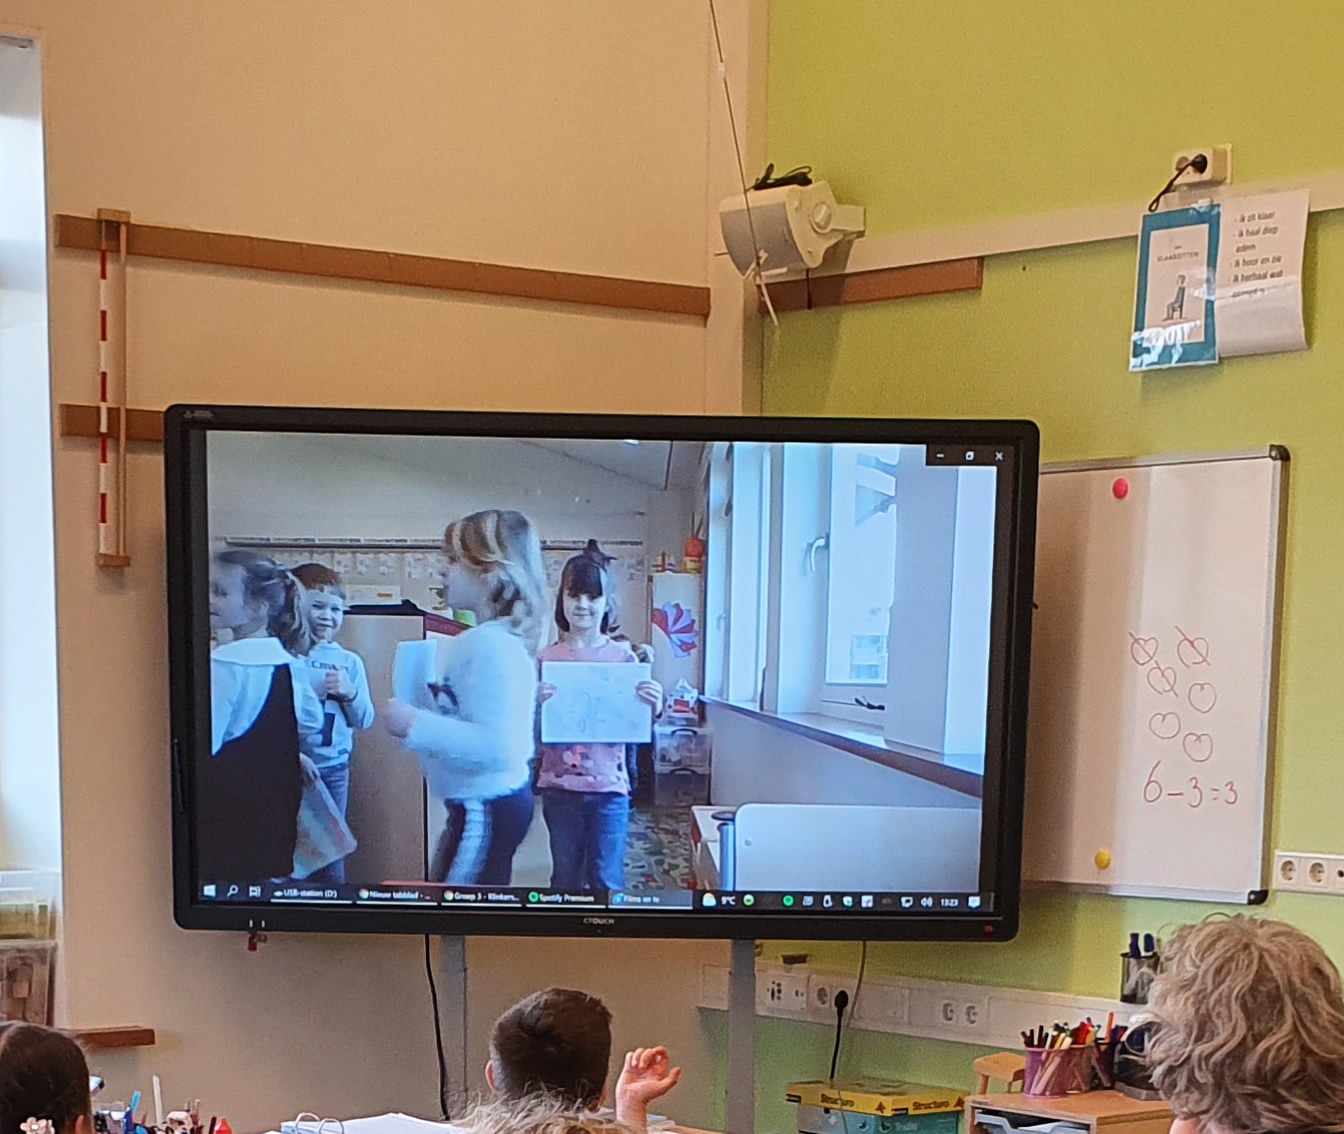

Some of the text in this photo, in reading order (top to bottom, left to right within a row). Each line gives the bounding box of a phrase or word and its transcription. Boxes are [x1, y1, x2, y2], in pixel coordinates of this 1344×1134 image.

[283, 889, 323, 898] USB-station
[539, 893, 595, 903] Spotify Premium
